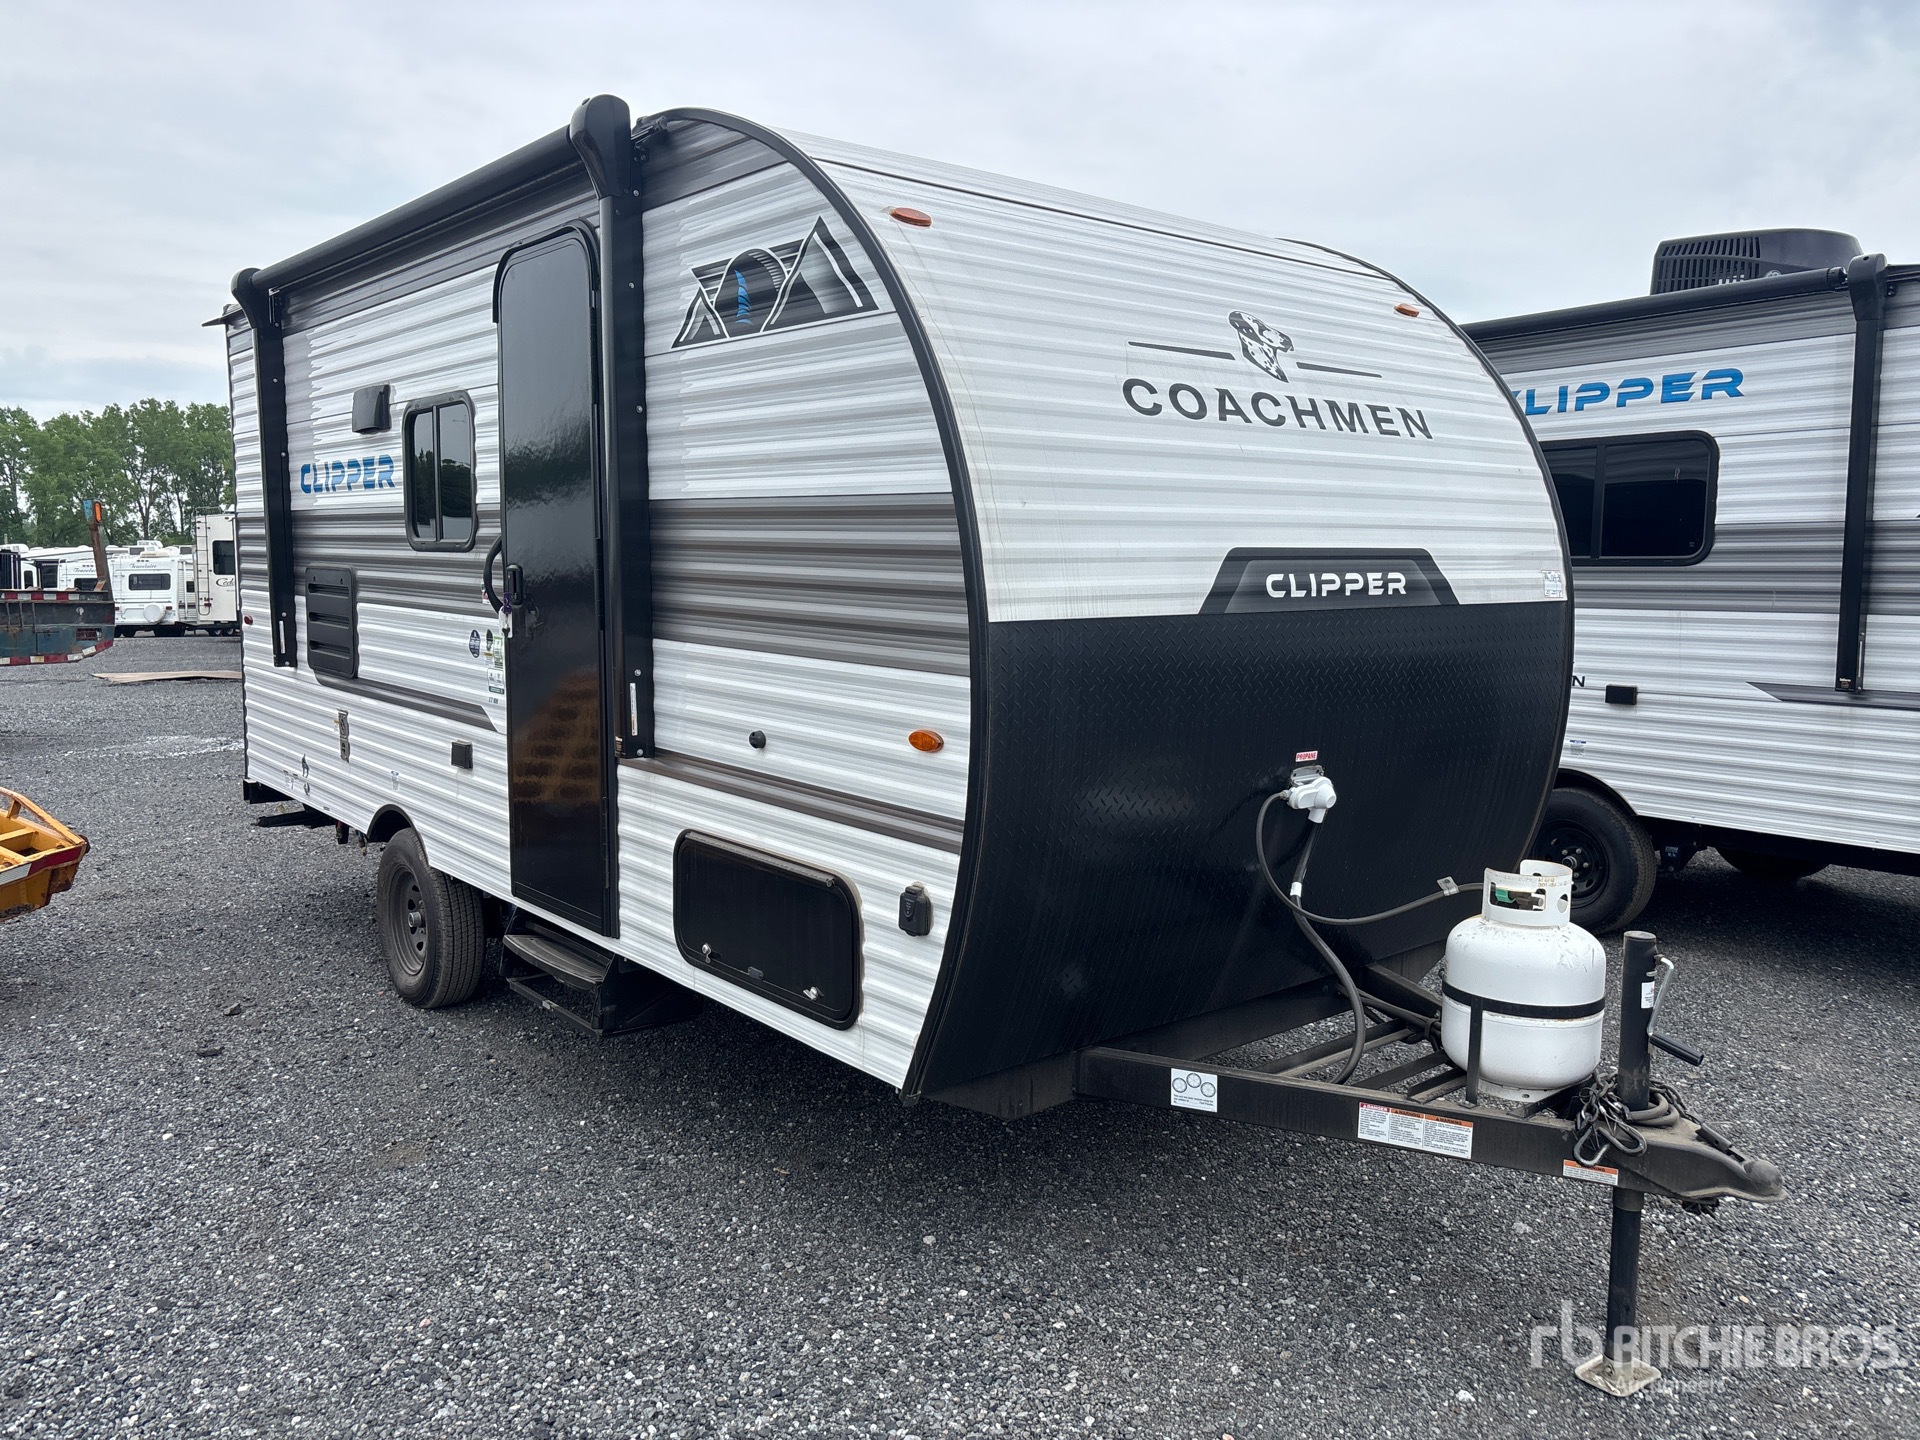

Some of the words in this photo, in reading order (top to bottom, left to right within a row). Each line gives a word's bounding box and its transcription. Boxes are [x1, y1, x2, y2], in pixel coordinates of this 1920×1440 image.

[1122, 378, 1433, 440] COACHMEN
[1511, 368, 1745, 416] LIPPER
[301, 454, 395, 494] CLIPPER
[1265, 572, 1407, 598] CLIPPER
[1296, 752, 1317, 761] PROPANE
